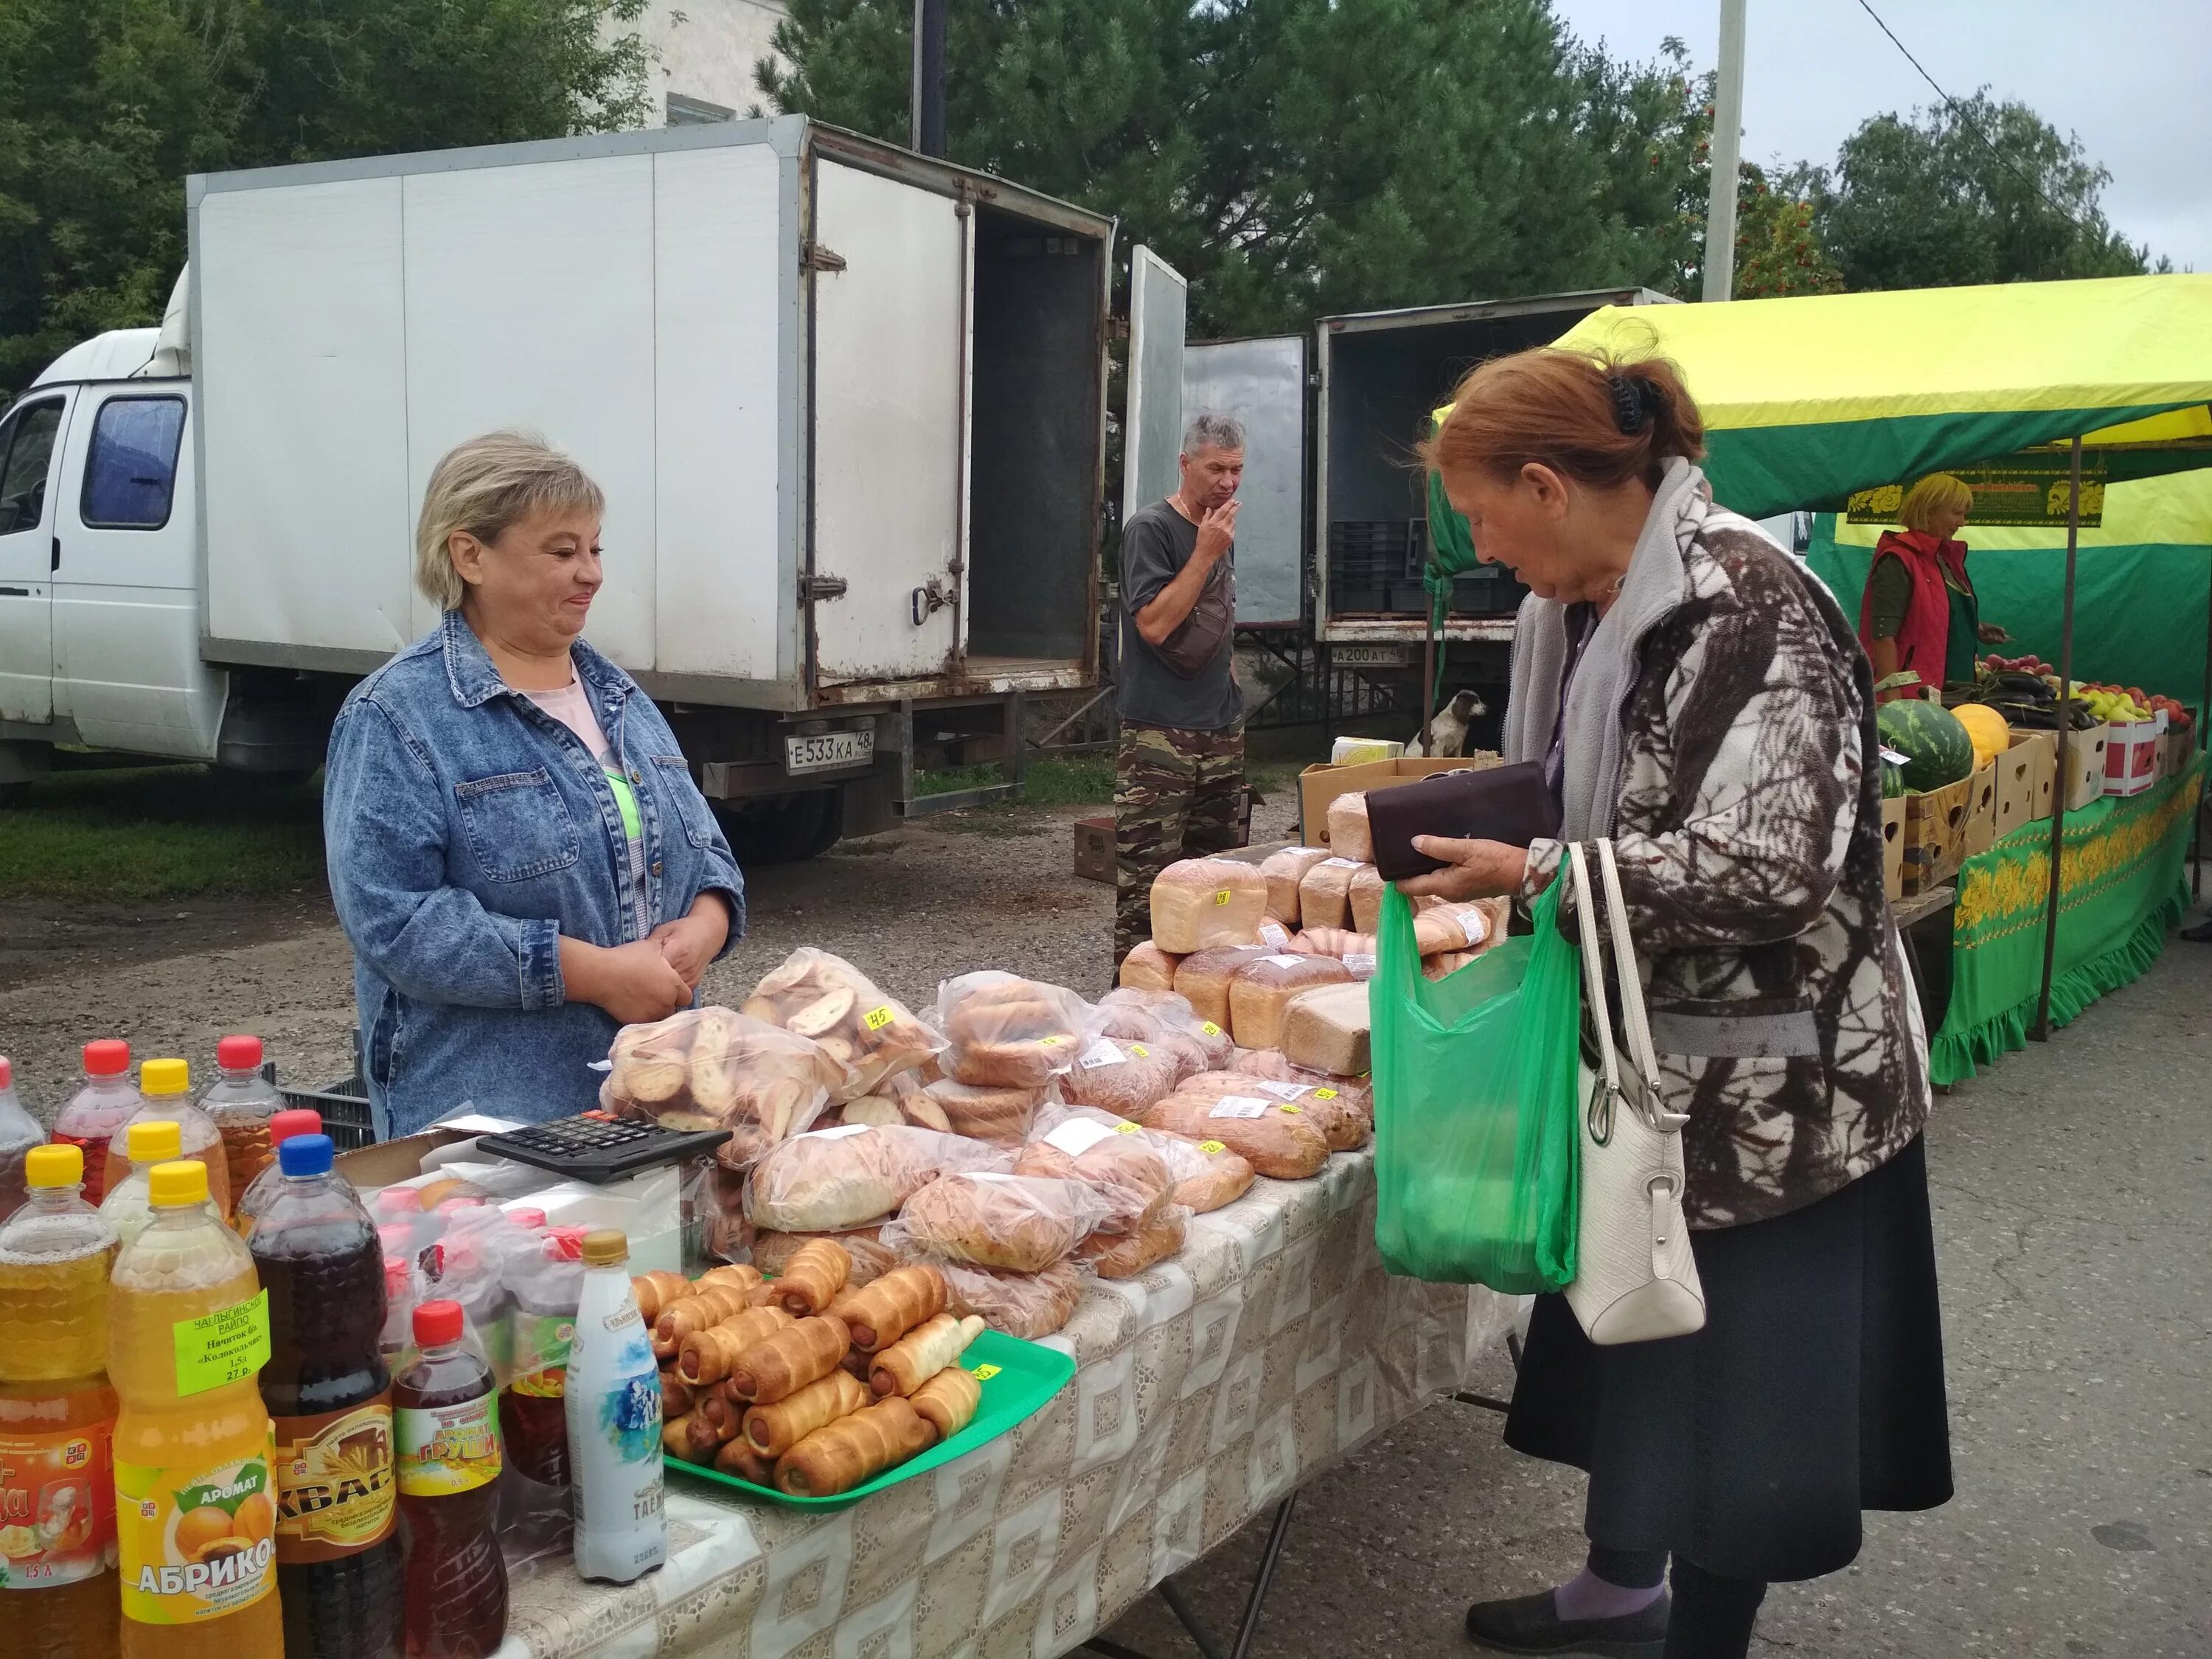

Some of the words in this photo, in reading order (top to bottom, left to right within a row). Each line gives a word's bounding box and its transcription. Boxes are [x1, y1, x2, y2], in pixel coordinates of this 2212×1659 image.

[1338, 649, 1386, 661] А200АТ
[794, 737, 852, 764] Е533КА
[857, 732, 869, 748] 48
[869, 1008, 886, 1026] 45
[218, 1315, 249, 1334] РАЙПО
[230, 1355, 247, 1368] 1,5л
[226, 1368, 240, 1380] 27
[434, 1422, 490, 1442] АРОМАТ
[418, 1431, 495, 1464] ГРУШИ
[201, 1475, 258, 1504] АРОМАТ
[451, 1478, 463, 1487] 0,5
[276, 1467, 391, 1523] КВАС
[25, 1564, 40, 1580] 1,5
[138, 1537, 276, 1595] АБРИКО
